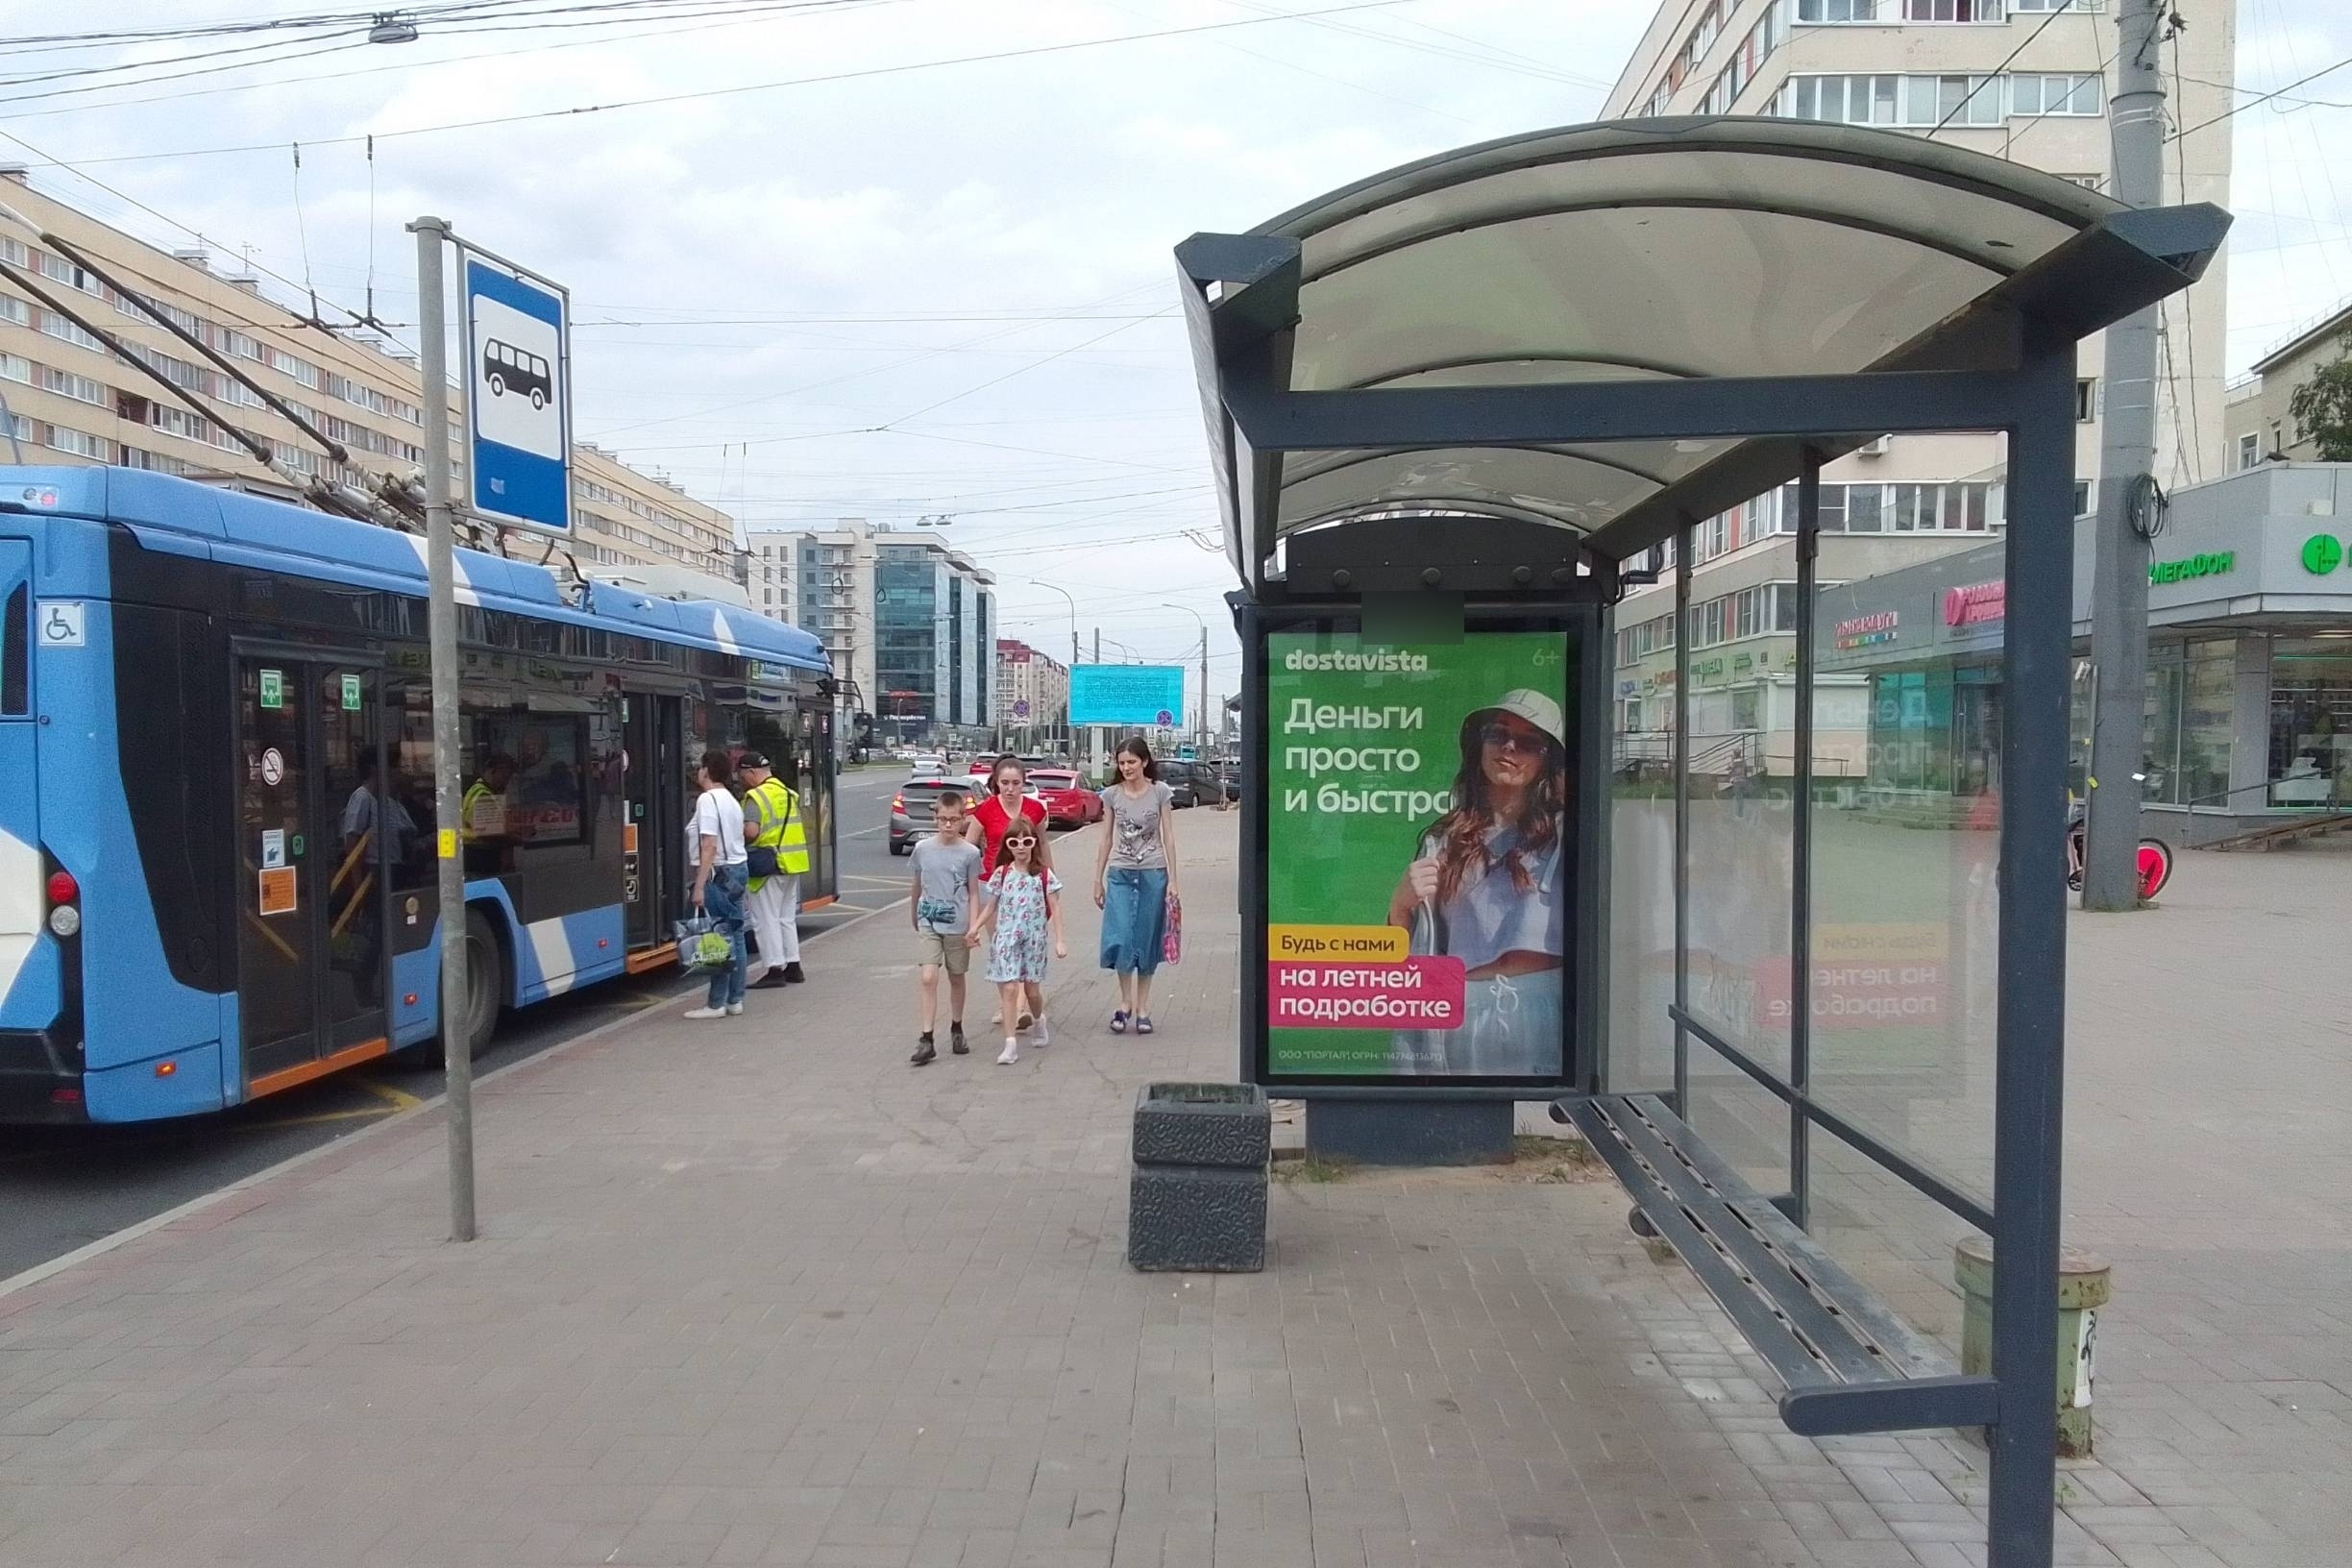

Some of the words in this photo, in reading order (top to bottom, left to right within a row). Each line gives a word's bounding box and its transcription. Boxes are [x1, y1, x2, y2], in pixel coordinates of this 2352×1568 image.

[1286, 649, 1428, 672] dostavista
[1532, 648, 1561, 667] 6+
[1285, 698, 1422, 734] Деньги
[1286, 747, 1420, 777] просто
[1286, 789, 1307, 812] и
[1282, 935, 1325, 952] Будь
[1331, 940, 1339, 951] с
[1343, 939, 1395, 952] нами
[1280, 968, 1315, 988] на
[1322, 965, 1422, 989] летней
[1280, 995, 1451, 1021] подработке
[1279, 1050, 1302, 1060] ООО
